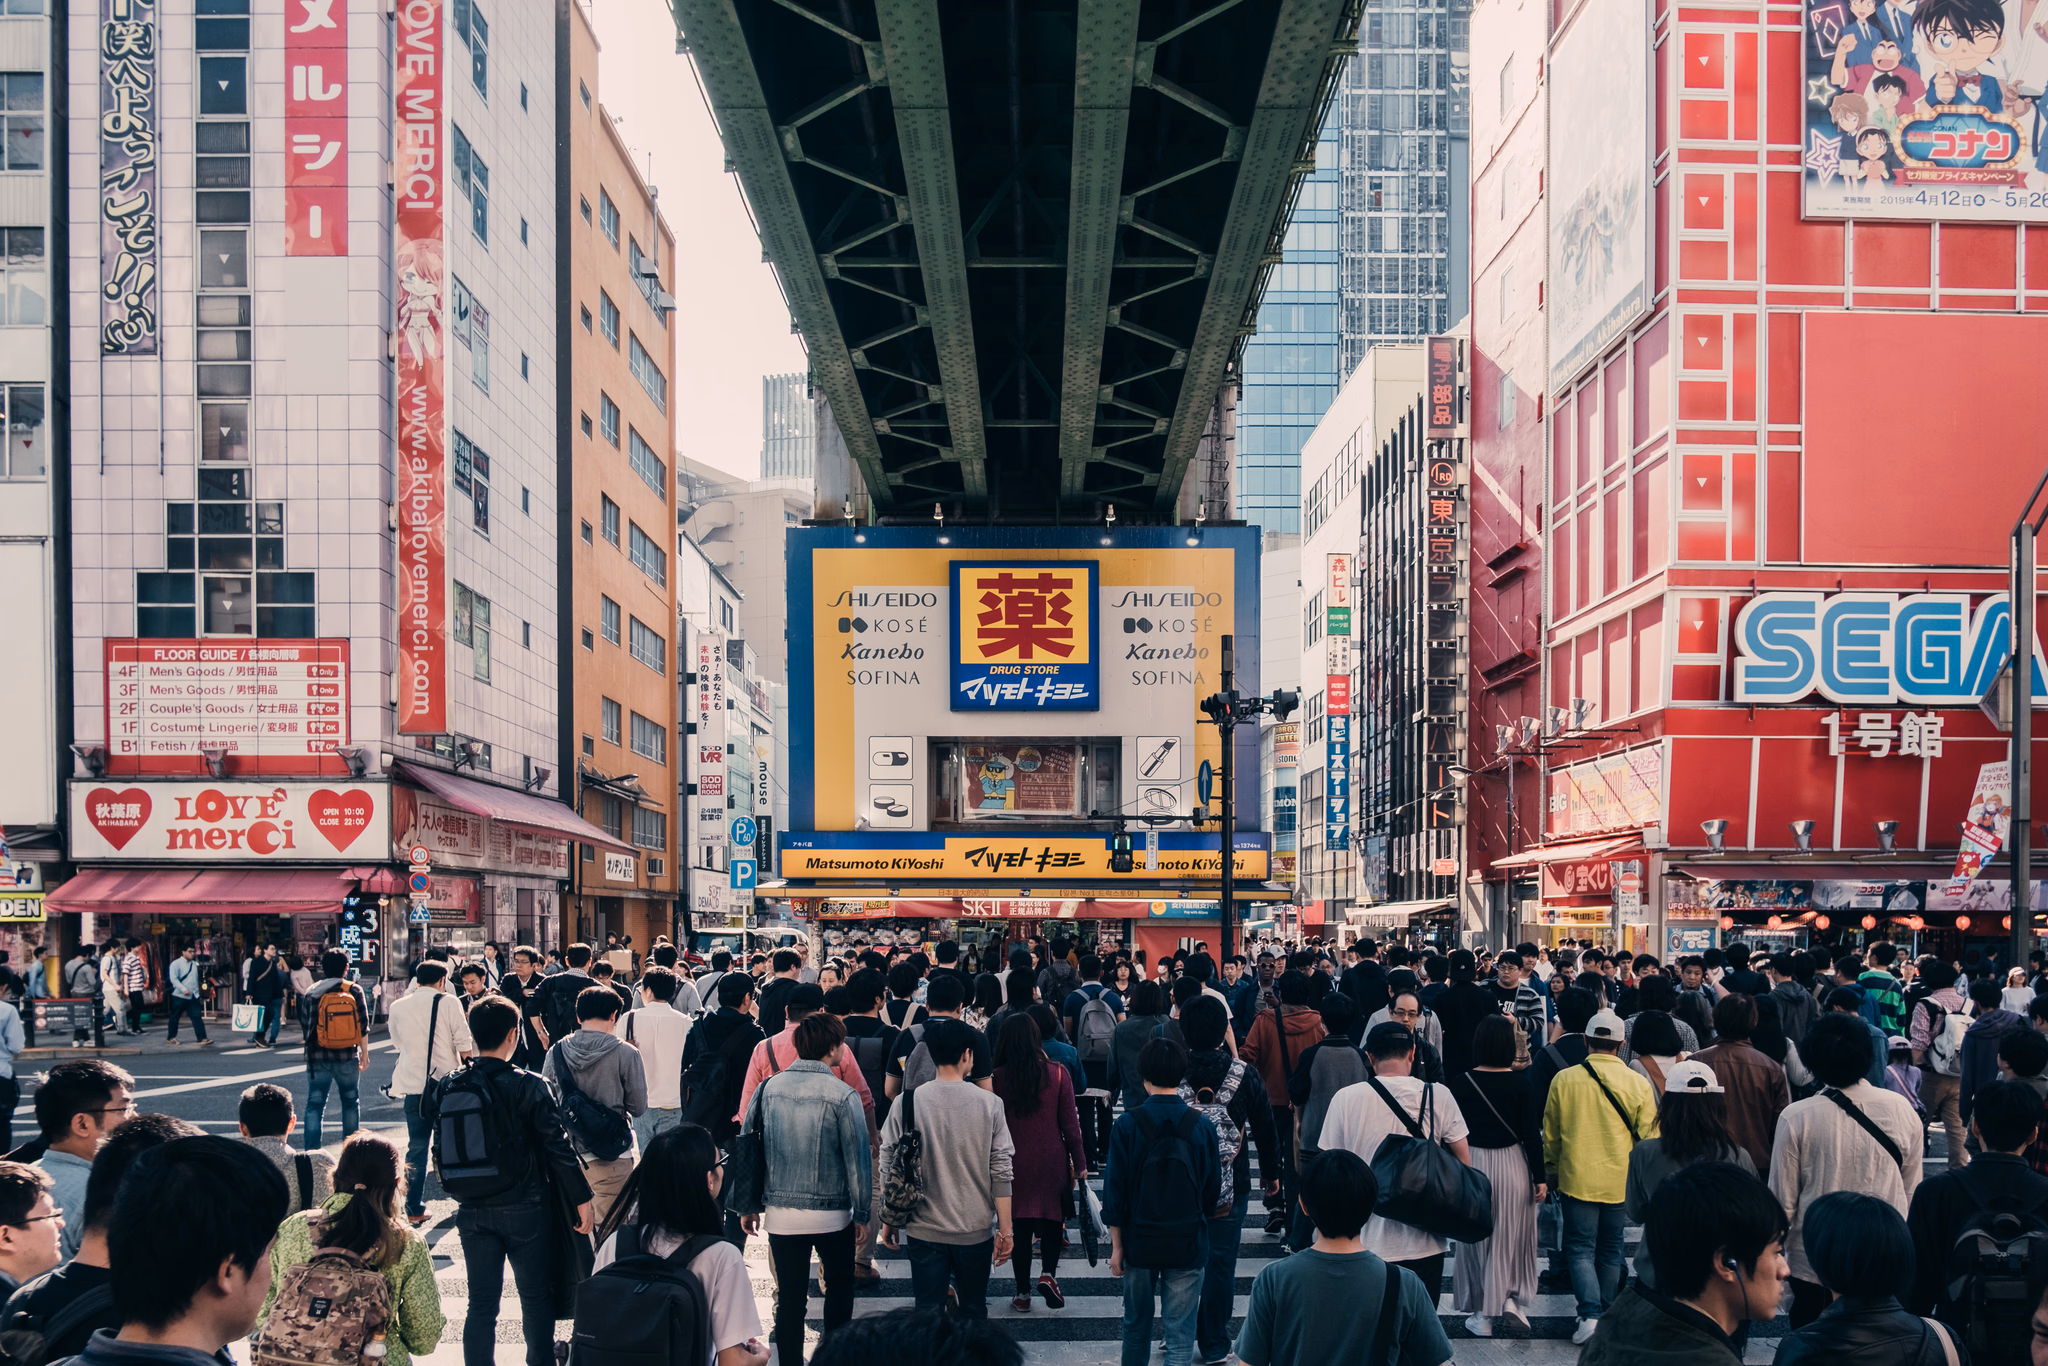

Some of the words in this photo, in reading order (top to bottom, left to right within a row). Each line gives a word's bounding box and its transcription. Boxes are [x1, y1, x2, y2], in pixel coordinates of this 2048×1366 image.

[290, 0, 342, 238] メルシー
[405, 89, 435, 209] MERCI
[1928, 129, 2011, 160] コナン
[1585, 341, 1594, 358] to
[1596, 296, 1641, 346] Akihabara
[1433, 342, 1453, 425] 電子部品
[412, 385, 434, 715] www.akibalovemerci.com
[827, 590, 938, 608] SHISEIDO
[1111, 590, 1222, 608] SHISEIDO
[874, 616, 927, 633] KOSÉ
[977, 573, 1075, 659] 薬
[1158, 616, 1213, 633] KOSÉ
[155, 649, 196, 660] FLOOR
[200, 649, 237, 660] GUIDE
[841, 642, 925, 660] Kanebo
[1125, 642, 1210, 660] Kanebo
[1735, 592, 2048, 703] SEGA
[119, 666, 137, 677] 4F
[150, 667, 183, 677] Men's
[186, 667, 225, 677] Goods
[236, 666, 278, 677] 男性用品
[320, 669, 334, 677] Only
[847, 670, 920, 686] SOFINA
[990, 665, 1020, 675] DRUG
[1024, 665, 1060, 675] STORE
[1131, 670, 1205, 686] SOFINA
[119, 684, 137, 696] 3F
[150, 685, 183, 695] Men's
[186, 685, 226, 695] Goods
[236, 684, 278, 695] 男性用品
[320, 687, 334, 696] Only
[960, 677, 1089, 706] マツモトキヨシ
[120, 703, 137, 715] 2F
[150, 704, 201, 717] Couple's
[205, 704, 245, 714] Goods
[257, 704, 298, 714] 女士用品
[325, 705, 336, 713] OK
[121, 722, 137, 733] 1F
[150, 722, 205, 733] Costume
[209, 722, 258, 735] Lingerie
[325, 723, 336, 732] OK
[1821, 711, 1945, 758] 1号館
[121, 741, 138, 752] B1
[151, 741, 187, 752] Fetish
[759, 761, 767, 805] mouse
[96, 803, 141, 819] 秋葉原
[174, 789, 283, 822] LOVE
[344, 807, 364, 816] 10:00
[1549, 793, 1568, 813] BIG
[319, 818, 339, 826] CLOSE
[344, 818, 364, 826] 22:00
[736, 823, 747, 842] P
[743, 833, 751, 842] 60
[414, 850, 426, 860] 20
[806, 857, 889, 870] Matsumoto
[891, 858, 945, 870] KiYoshi
[965, 846, 1085, 874] マツモトキヨシ
[736, 862, 752, 887] P
[1859, 884, 1884, 894] コナン
[0, 898, 41, 917] DEN
